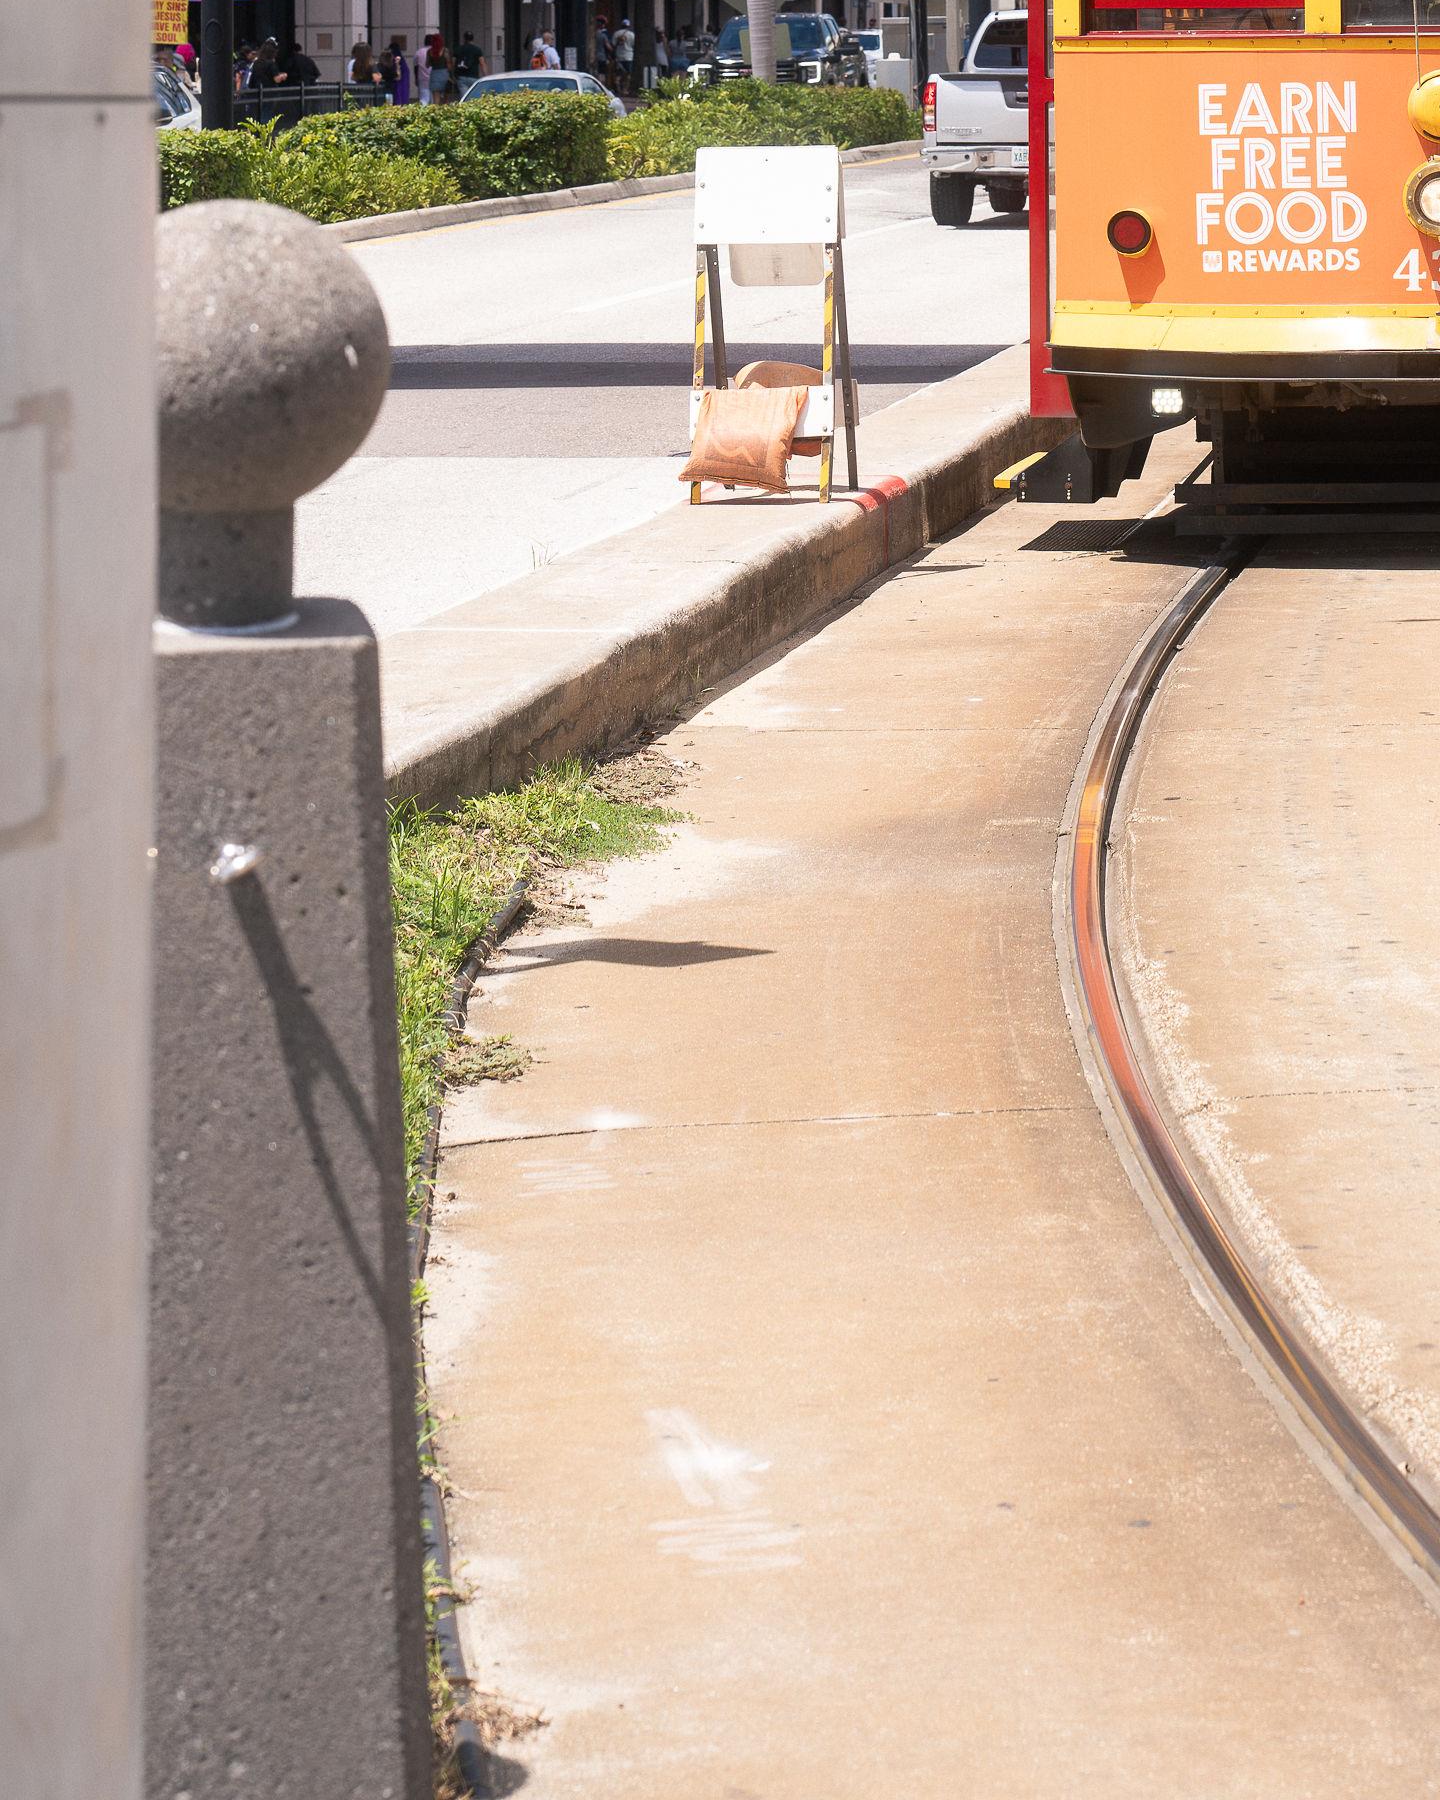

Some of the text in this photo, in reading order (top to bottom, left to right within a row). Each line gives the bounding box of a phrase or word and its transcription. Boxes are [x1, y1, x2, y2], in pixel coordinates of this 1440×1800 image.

[155, 11, 181, 22] JESUS
[166, 1, 187, 12] SINS
[172, 23, 187, 33] MY
[1198, 80, 1357, 136] EARN
[1210, 136, 1348, 190] FREE
[1195, 190, 1368, 246] FOOD
[1227, 247, 1361, 273] REWARDS
